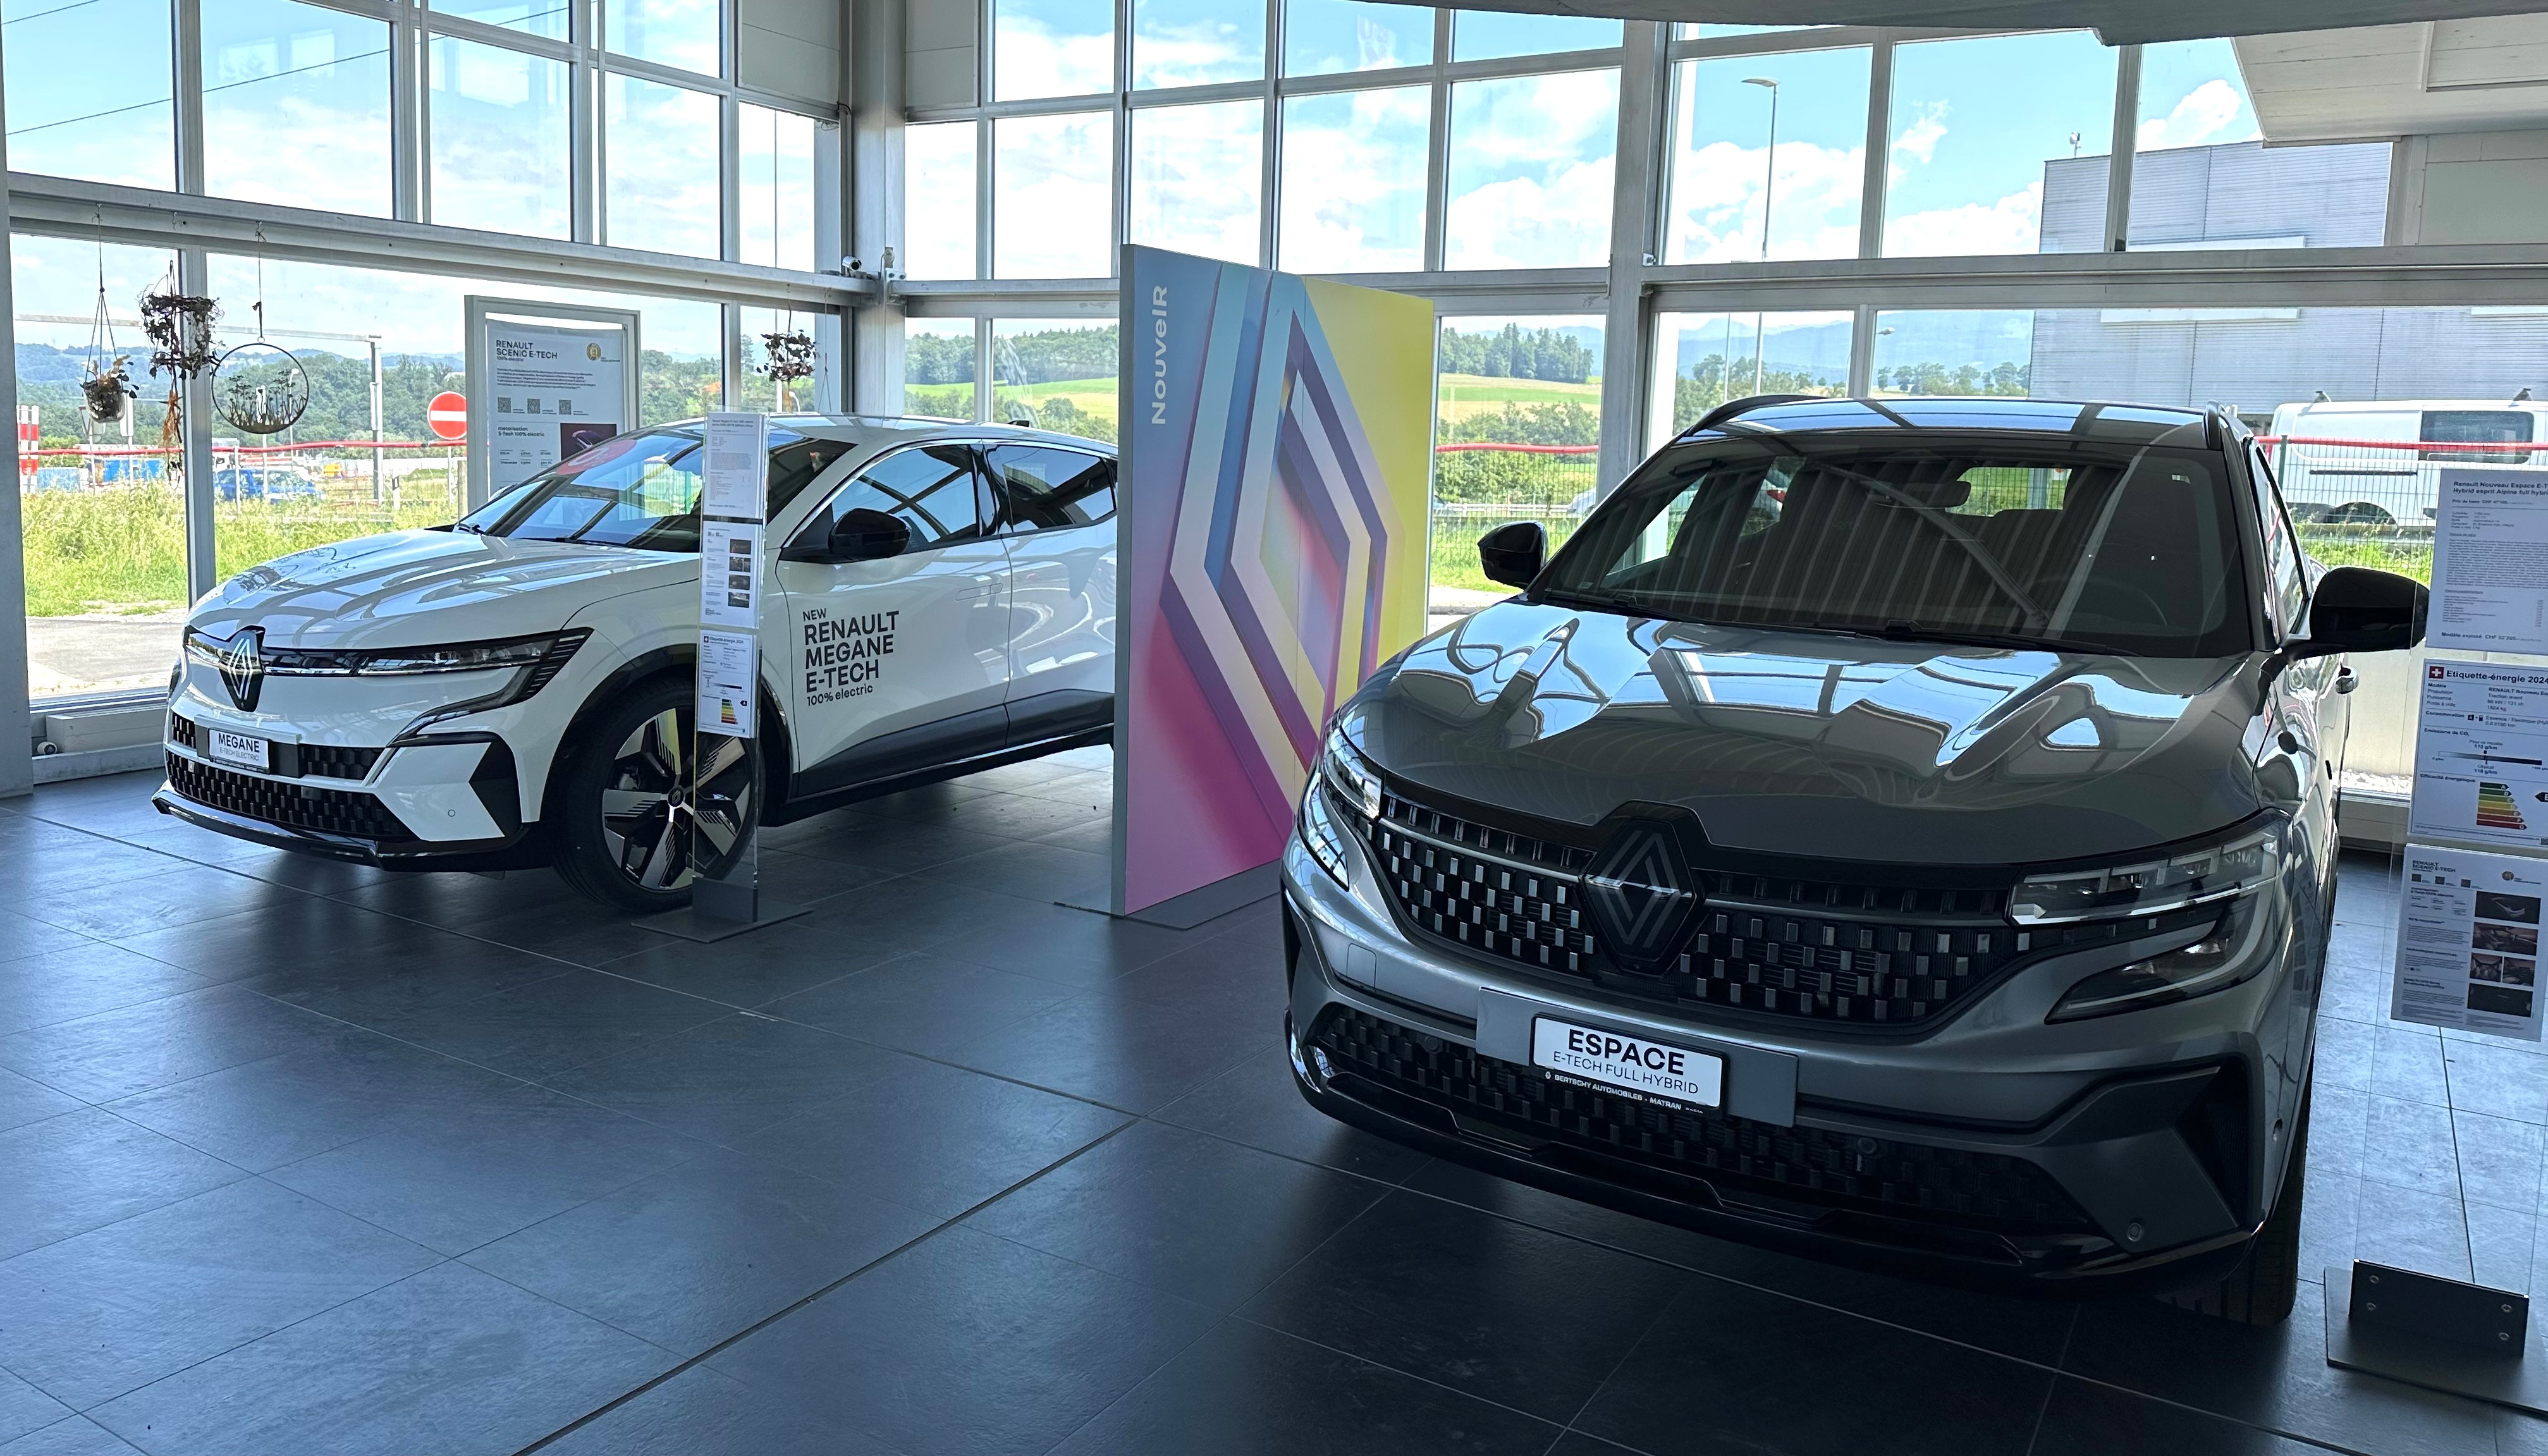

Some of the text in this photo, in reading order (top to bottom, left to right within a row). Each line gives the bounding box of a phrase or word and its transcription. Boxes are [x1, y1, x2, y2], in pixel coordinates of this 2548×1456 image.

[496, 340, 534, 350] RENAULT
[496, 348, 558, 359] SCENIC E-TECH
[802, 608, 827, 621] NEW
[804, 610, 899, 645] RENAULT
[805, 634, 893, 670] MEGANE
[806, 659, 879, 693] E-TECH
[2447, 670, 2525, 683] Etiquette-énergie
[807, 683, 873, 706] 100% electric
[218, 733, 260, 753] MEGANE
[220, 747, 259, 761] E-TECH ELECTRIC
[1568, 1029, 1685, 1075] ESPACE
[1553, 1051, 1698, 1094] E-TECH FULL HYBRID
[1554, 1074, 1592, 1089] BERTSCHY
[1592, 1084, 1643, 1101] AUTOMOBILES
[1650, 1097, 1682, 1110] MATRAN
